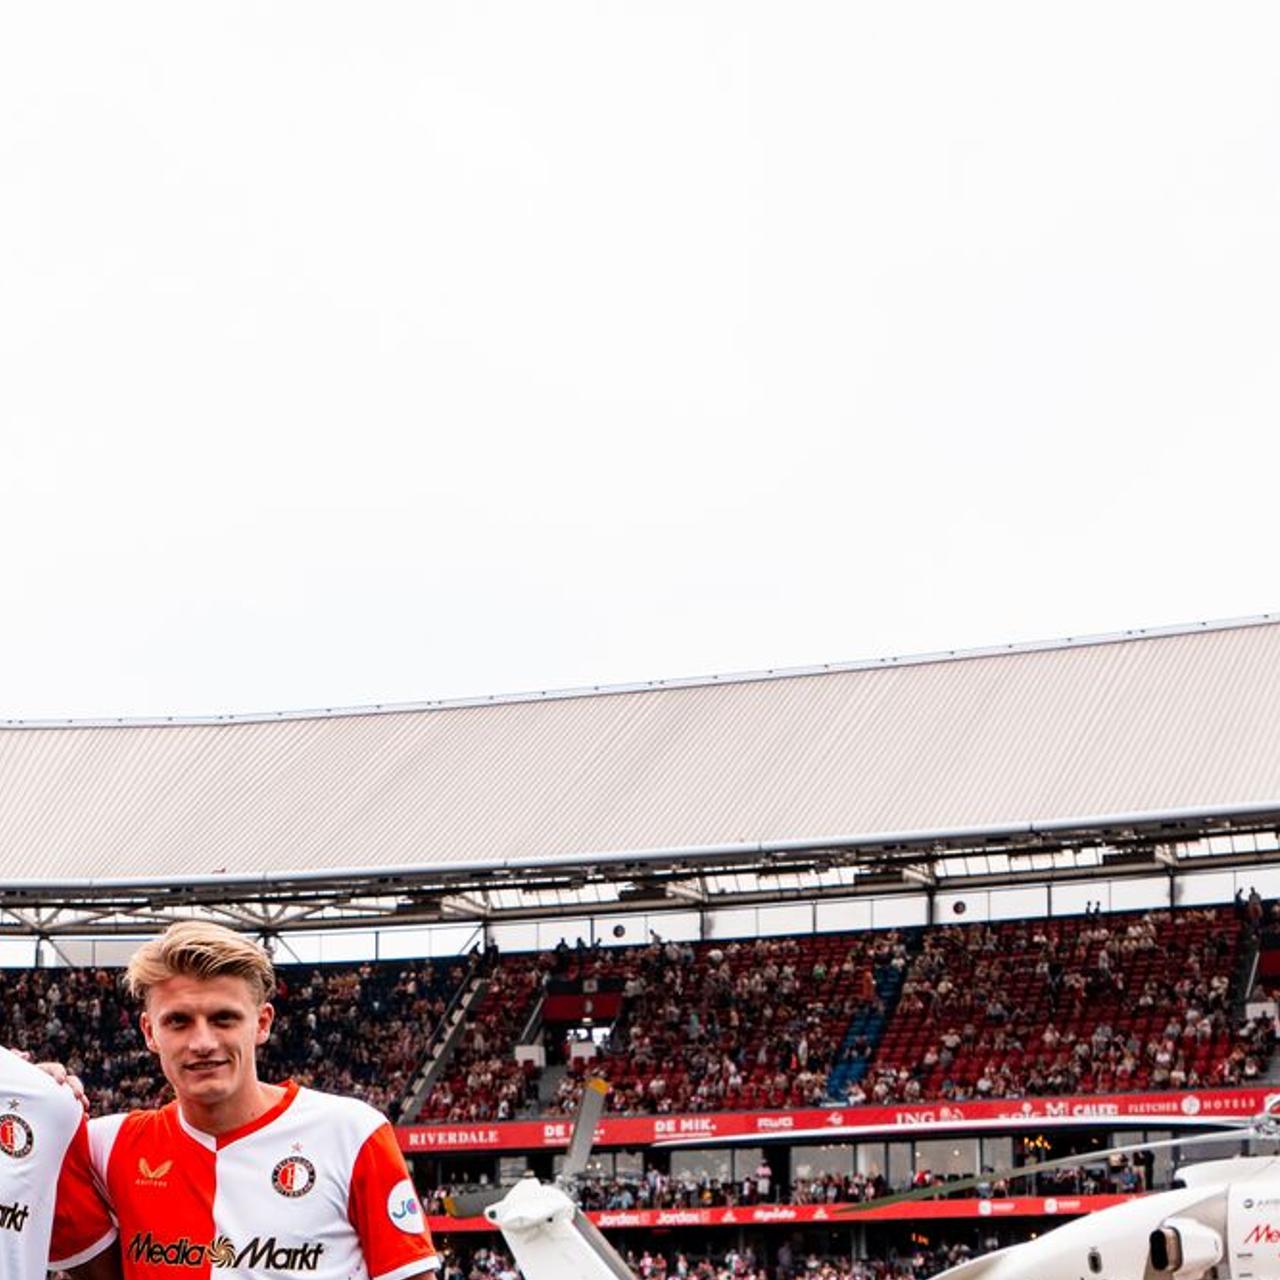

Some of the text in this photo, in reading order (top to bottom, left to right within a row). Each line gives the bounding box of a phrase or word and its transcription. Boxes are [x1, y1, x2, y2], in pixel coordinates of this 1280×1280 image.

[1128, 1098, 1256, 1114] FLETCHER HOTELS
[655, 1120, 676, 1132] DE
[409, 1130, 500, 1146] RIVERDALE
[126, 1232, 325, 1272] Media Markt
